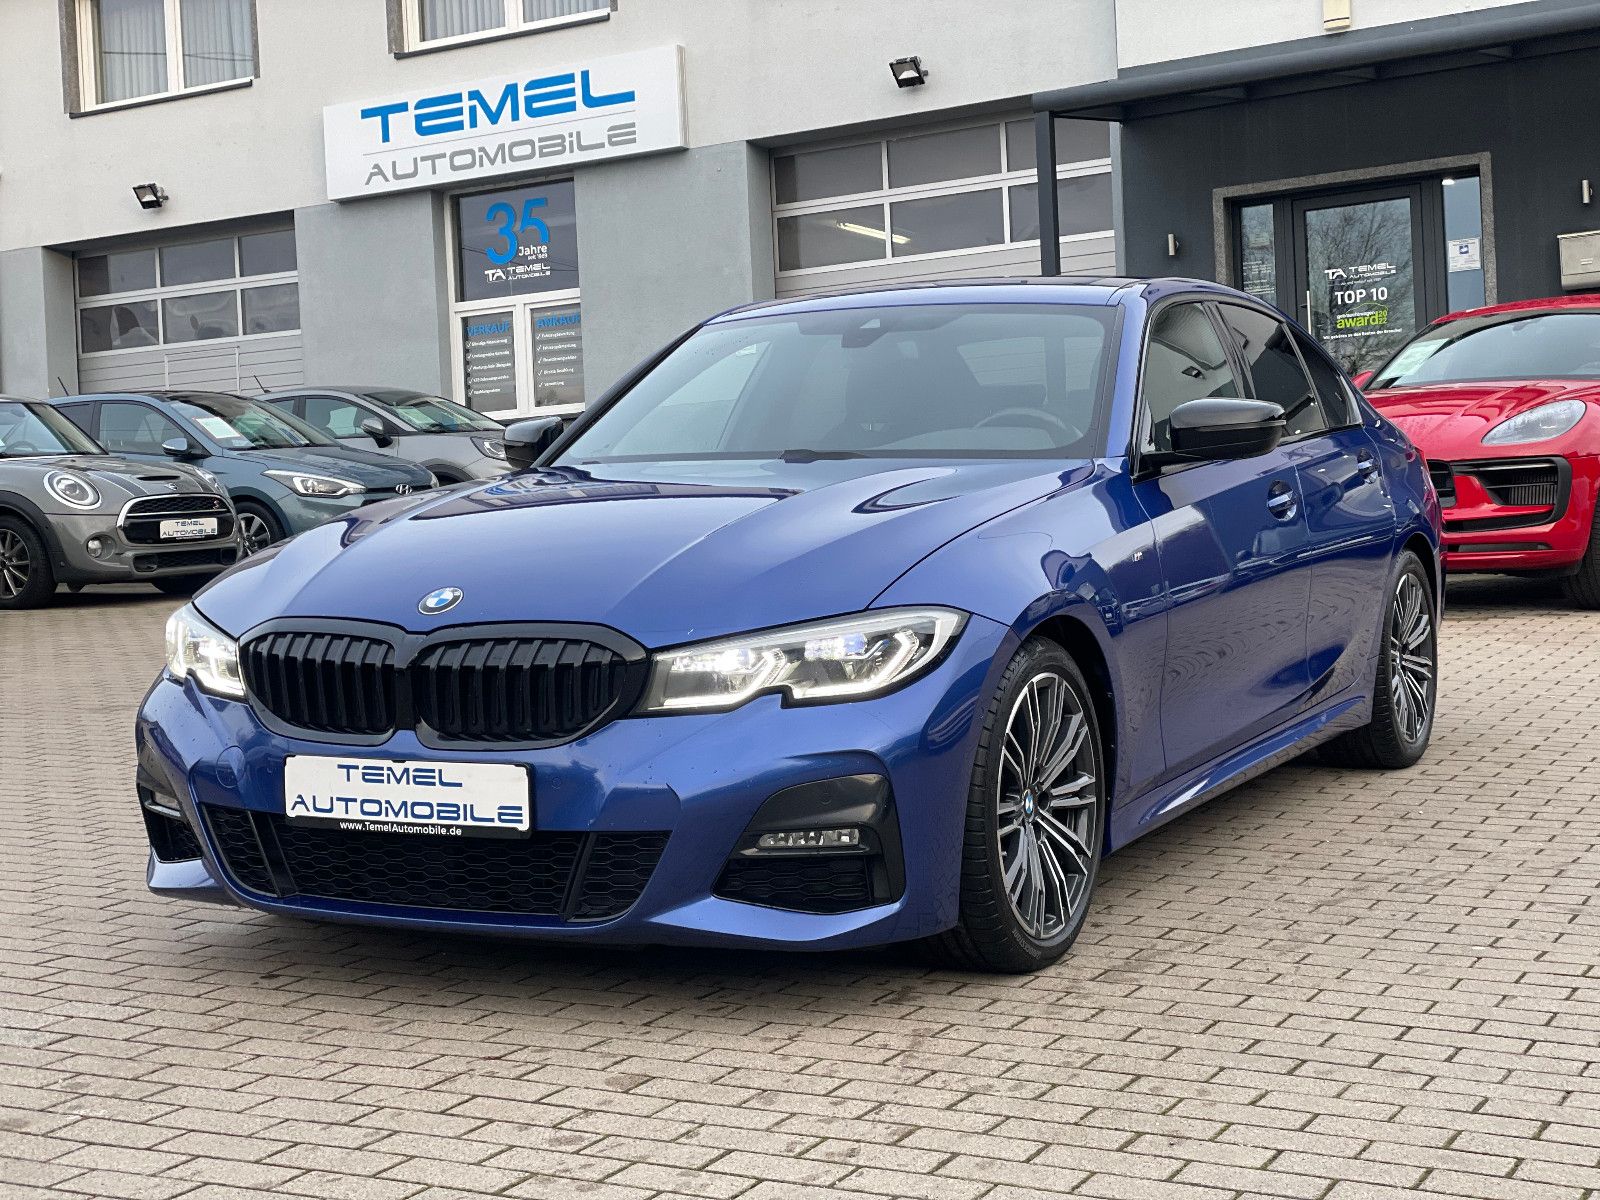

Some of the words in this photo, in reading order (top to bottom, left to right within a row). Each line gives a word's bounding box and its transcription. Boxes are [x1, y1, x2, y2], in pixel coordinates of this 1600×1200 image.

[361, 70, 636, 143] TEMEL
[485, 197, 550, 265] 35
[519, 245, 547, 256] Jahre
[507, 263, 550, 274] TEMEL
[1349, 263, 1396, 272] TEMEL
[1334, 288, 1367, 305] TOP
[1370, 286, 1388, 301] 10
[467, 320, 508, 336] VERKAUF
[1336, 311, 1379, 329] award
[162, 528, 216, 536] AUTOMOBILE
[337, 764, 463, 788] TEMEL
[290, 794, 524, 825] AUTOMOBILE
[339, 820, 463, 836] www.TemelAutomobile.de
